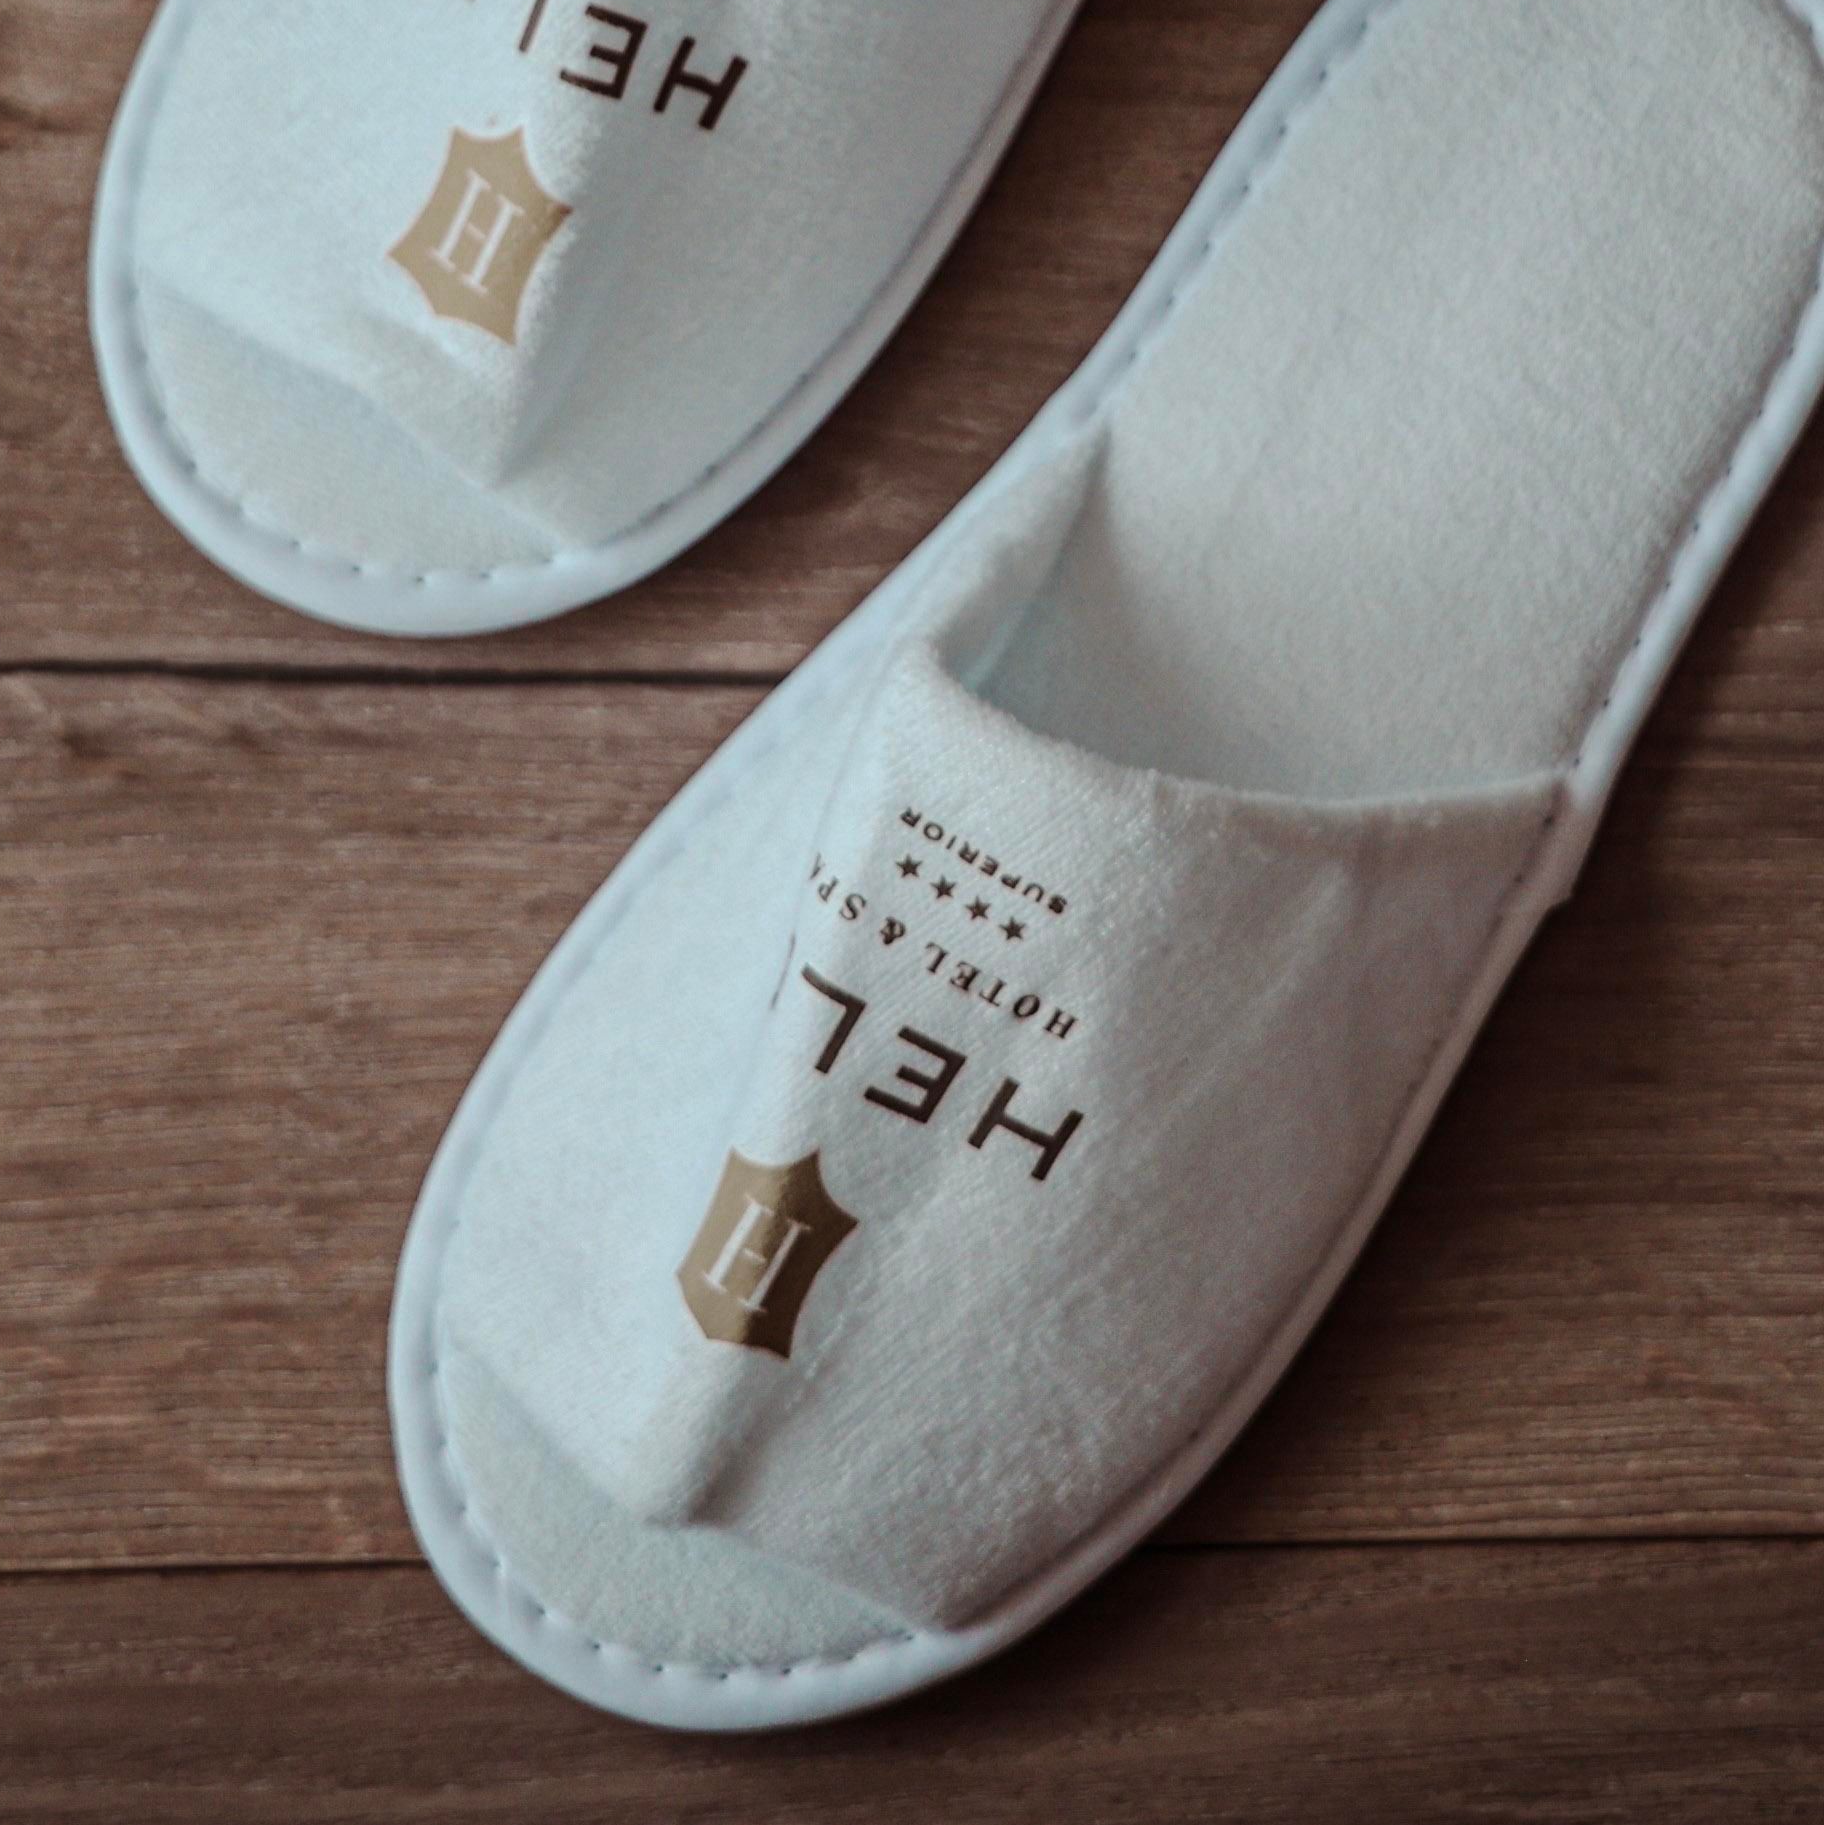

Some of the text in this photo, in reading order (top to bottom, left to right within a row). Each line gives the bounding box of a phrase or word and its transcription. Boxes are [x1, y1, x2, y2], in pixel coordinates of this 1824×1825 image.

[428, 167, 526, 296] H
[899, 806, 1069, 916] SUPERIOR
[880, 916, 906, 945] &
[924, 941, 1079, 1039] HOTEL
[773, 934, 1085, 1182] HEL
[704, 1194, 812, 1312] H
